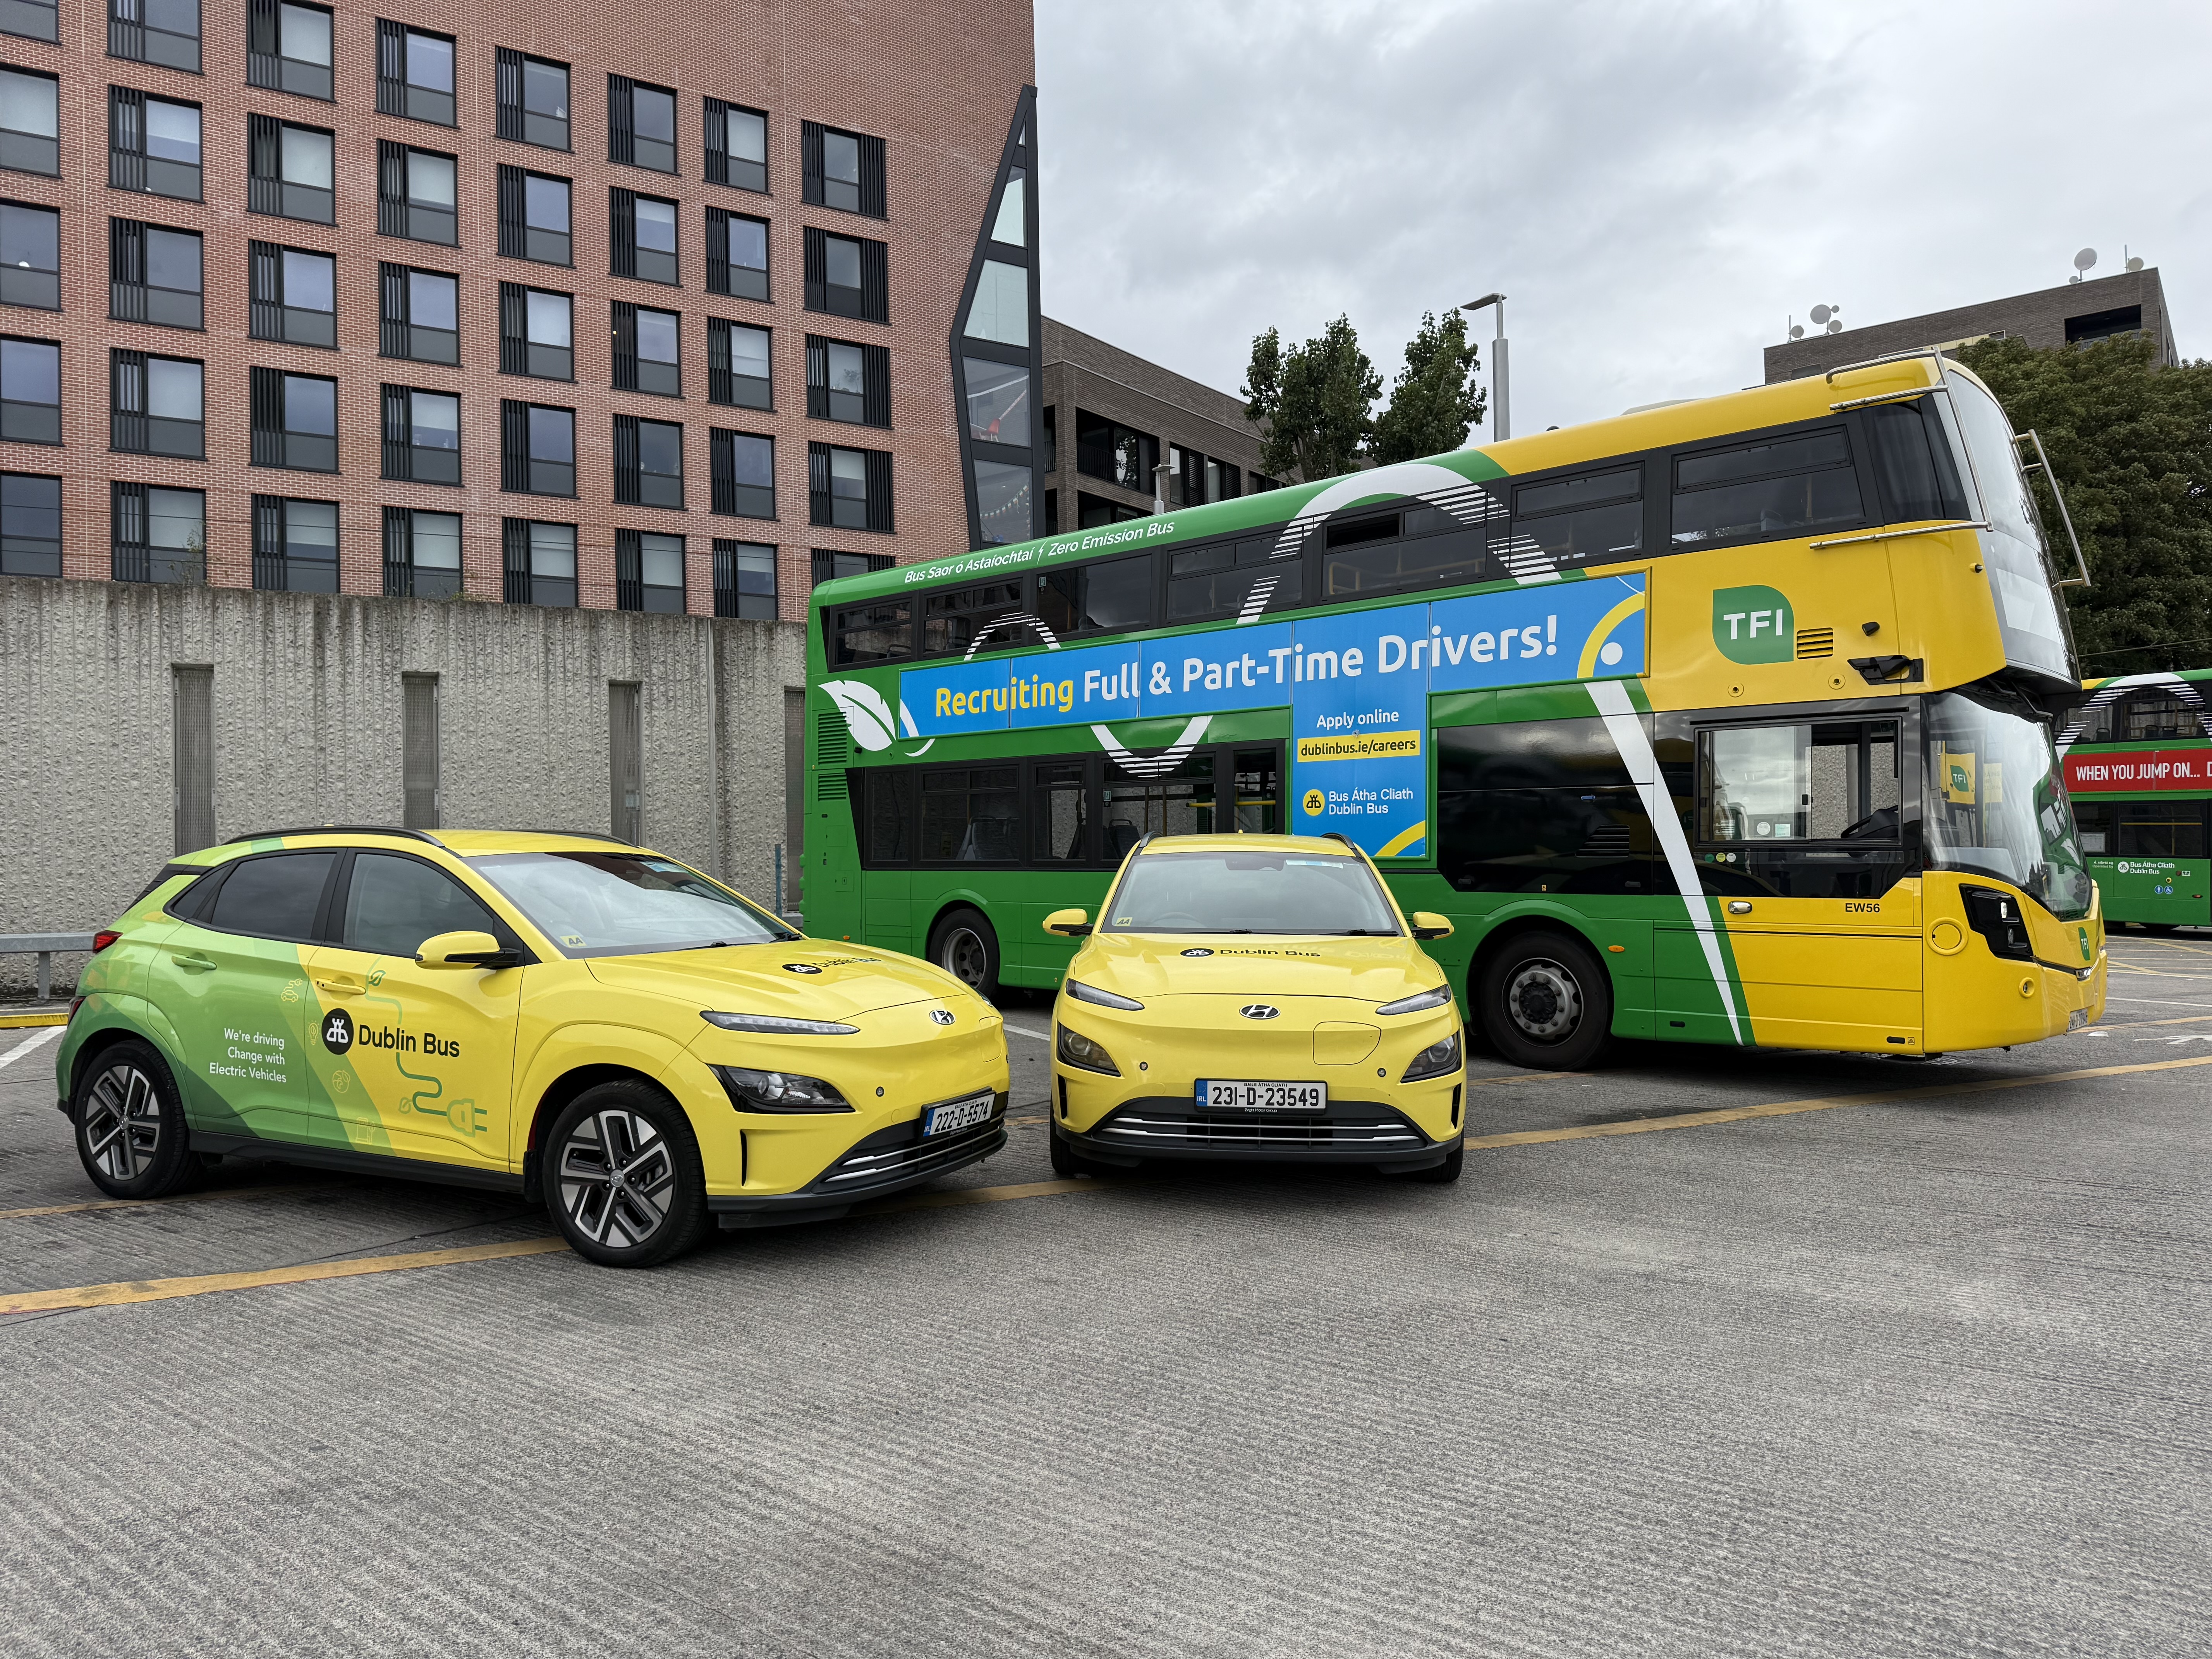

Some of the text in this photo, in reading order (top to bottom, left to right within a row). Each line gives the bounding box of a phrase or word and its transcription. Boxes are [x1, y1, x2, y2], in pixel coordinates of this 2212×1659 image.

[905, 522, 1175, 583] Bus Saor ó Astaíochtaí Zero Emission Bus
[1723, 609, 1783, 640] TFI
[936, 615, 1557, 717] Recruiting Full & Part-Time Drivers!
[1316, 709, 1399, 730] Apply online
[1301, 740, 1416, 756] dublinbus.ie/careers
[1953, 774, 1966, 783] TFI
[2076, 765, 2108, 781] WHEN
[2111, 764, 2134, 780] YOU
[2136, 763, 2170, 779] JUMP
[2173, 762, 2200, 778] ON...
[1329, 787, 1413, 802] Bus Átha Cliath
[1329, 803, 1388, 815] Dublin Bus
[1845, 903, 1880, 912] EW56
[224, 1027, 285, 1051] We're driving
[359, 1024, 460, 1058] Dublin Bus
[227, 1046, 285, 1065] Change with
[209, 1062, 287, 1084] Electric Vehicles
[1212, 1087, 1319, 1106] 231-D-23549
[934, 1100, 989, 1133] 222-D-5574
